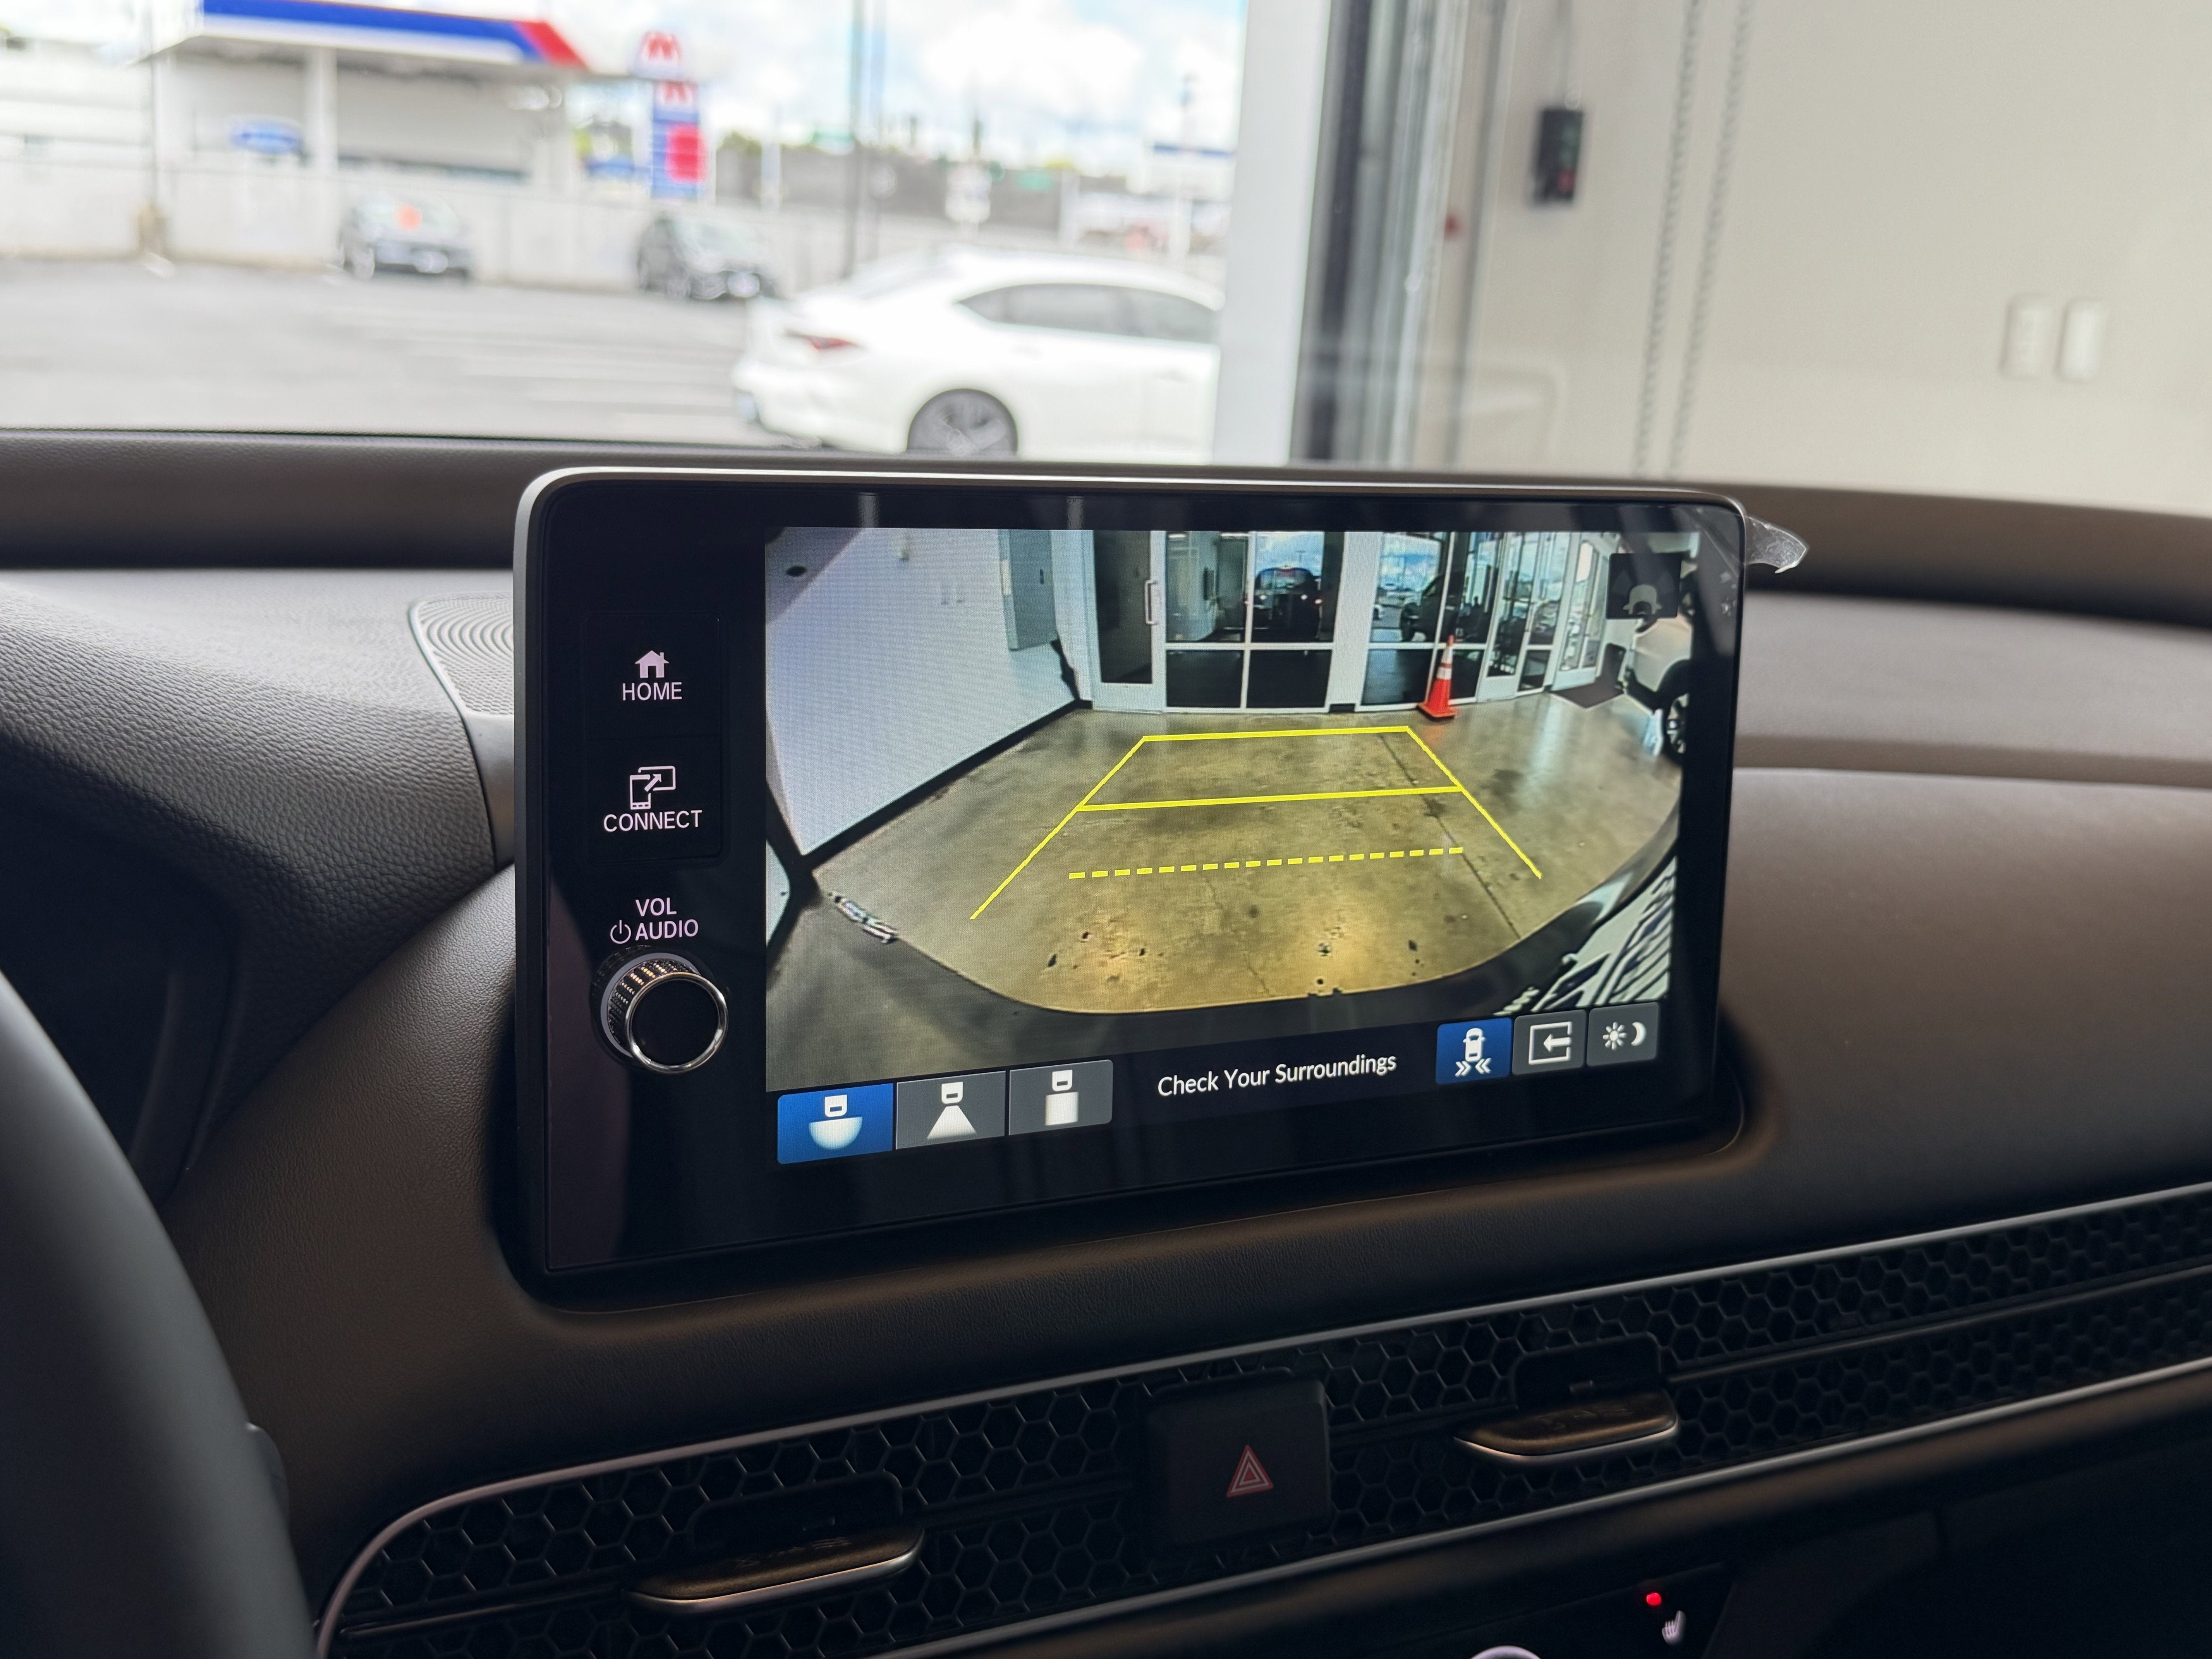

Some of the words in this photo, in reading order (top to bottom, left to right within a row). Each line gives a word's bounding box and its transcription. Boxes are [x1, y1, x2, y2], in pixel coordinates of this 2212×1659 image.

[622, 682, 682, 701] HOME
[603, 810, 702, 832] CONNECT
[635, 897, 677, 917] VOL
[635, 919, 699, 941] AUDIO
[1158, 1071, 1219, 1096] Check
[1224, 1068, 1270, 1089] Your
[1275, 1054, 1397, 1084] Surroundings
